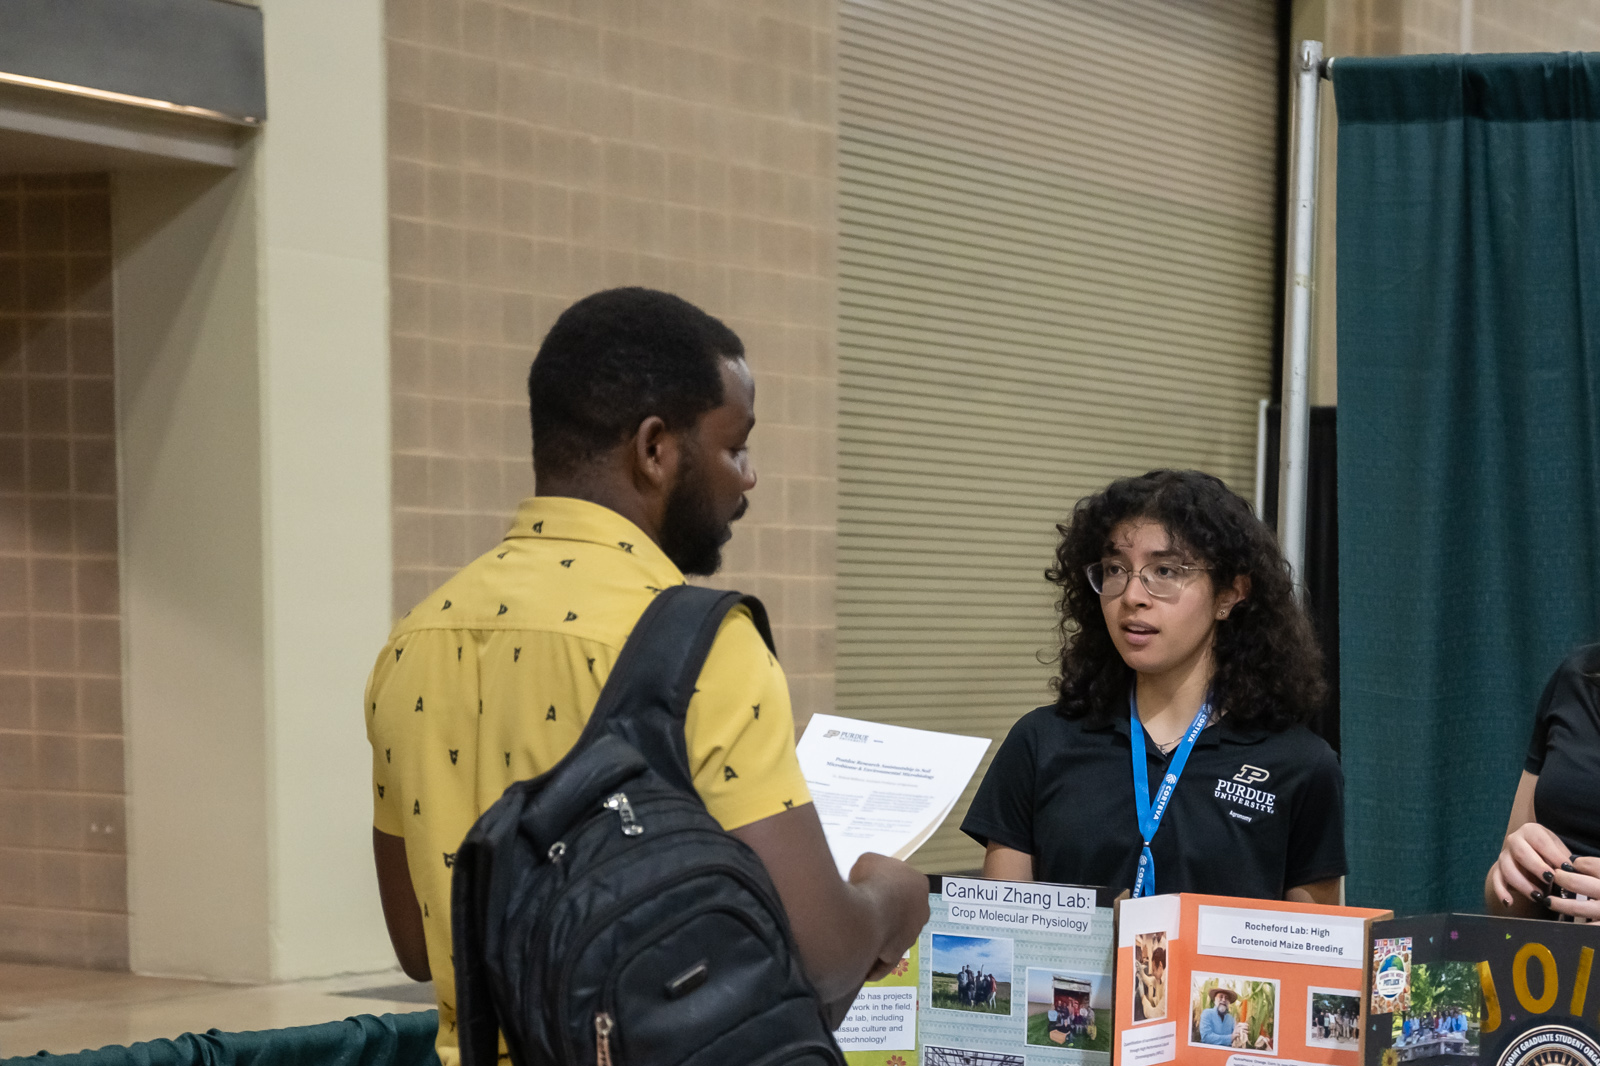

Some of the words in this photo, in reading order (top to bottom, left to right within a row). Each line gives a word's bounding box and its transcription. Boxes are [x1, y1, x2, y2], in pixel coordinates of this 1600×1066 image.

[840, 731, 869, 741] PURDUE
[1187, 714, 1208, 743] CORTEVA
[1153, 785, 1172, 820] CORTEVA
[1214, 778, 1276, 807] PURDUE
[945, 881, 998, 901] Cankui
[1002, 886, 1051, 910] Zhang
[1057, 891, 1090, 909] Lab:
[951, 906, 976, 921] Crop
[979, 909, 1028, 924] Molecular
[1031, 914, 1089, 932] Physiology
[1290, 926, 1309, 935] Lab:
[1311, 928, 1330, 938] High
[1230, 935, 1278, 948] Carotenoid
[1279, 940, 1303, 950] Maize
[1305, 943, 1343, 955] Breeding
[883, 993, 913, 1003] projects
[895, 1003, 912, 1011] field,
[1520, 1034, 1554, 1051] GRADUATE
[1555, 1034, 1585, 1051] STUDENT
